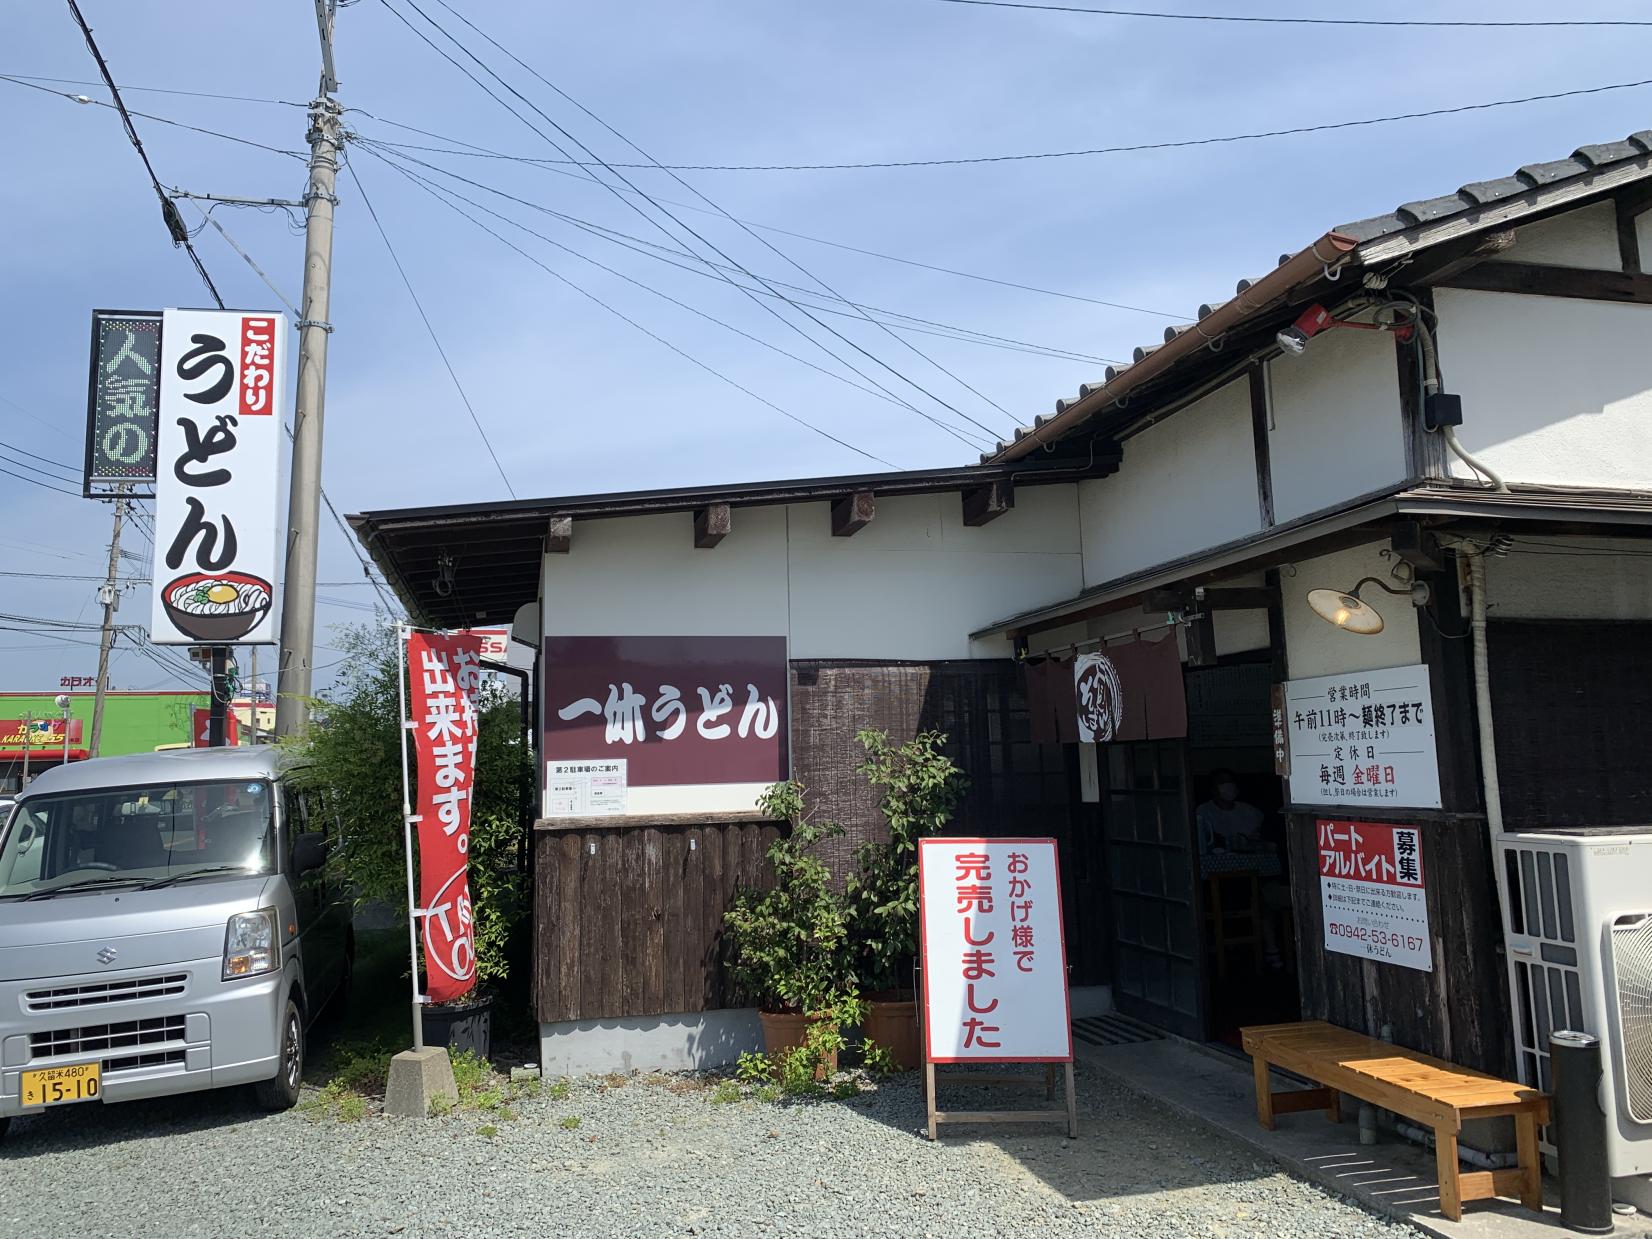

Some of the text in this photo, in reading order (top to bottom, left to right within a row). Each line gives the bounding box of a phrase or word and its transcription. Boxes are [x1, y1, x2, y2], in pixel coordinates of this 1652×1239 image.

[243, 320, 271, 412] こだわり
[102, 330, 151, 464] 人気の
[166, 333, 239, 571] うどん
[60, 676, 100, 688] カラオ
[1327, 683, 1371, 702] 営業時間
[558, 683, 778, 744] 一休うどん
[421, 649, 469, 854] 出来ます。
[1333, 745, 1375, 761] 定休日
[1319, 764, 1395, 786] 毎週 金曜日
[1320, 823, 1363, 850] パート
[1396, 830, 1419, 882] 募集
[1320, 850, 1395, 881] アルバイト
[1007, 852, 1035, 972] おかげ様で
[955, 852, 1001, 1048] 完売しました
[1338, 923, 1424, 951] 0942-53-6167
[41, 1078, 98, 1104] 15-10
